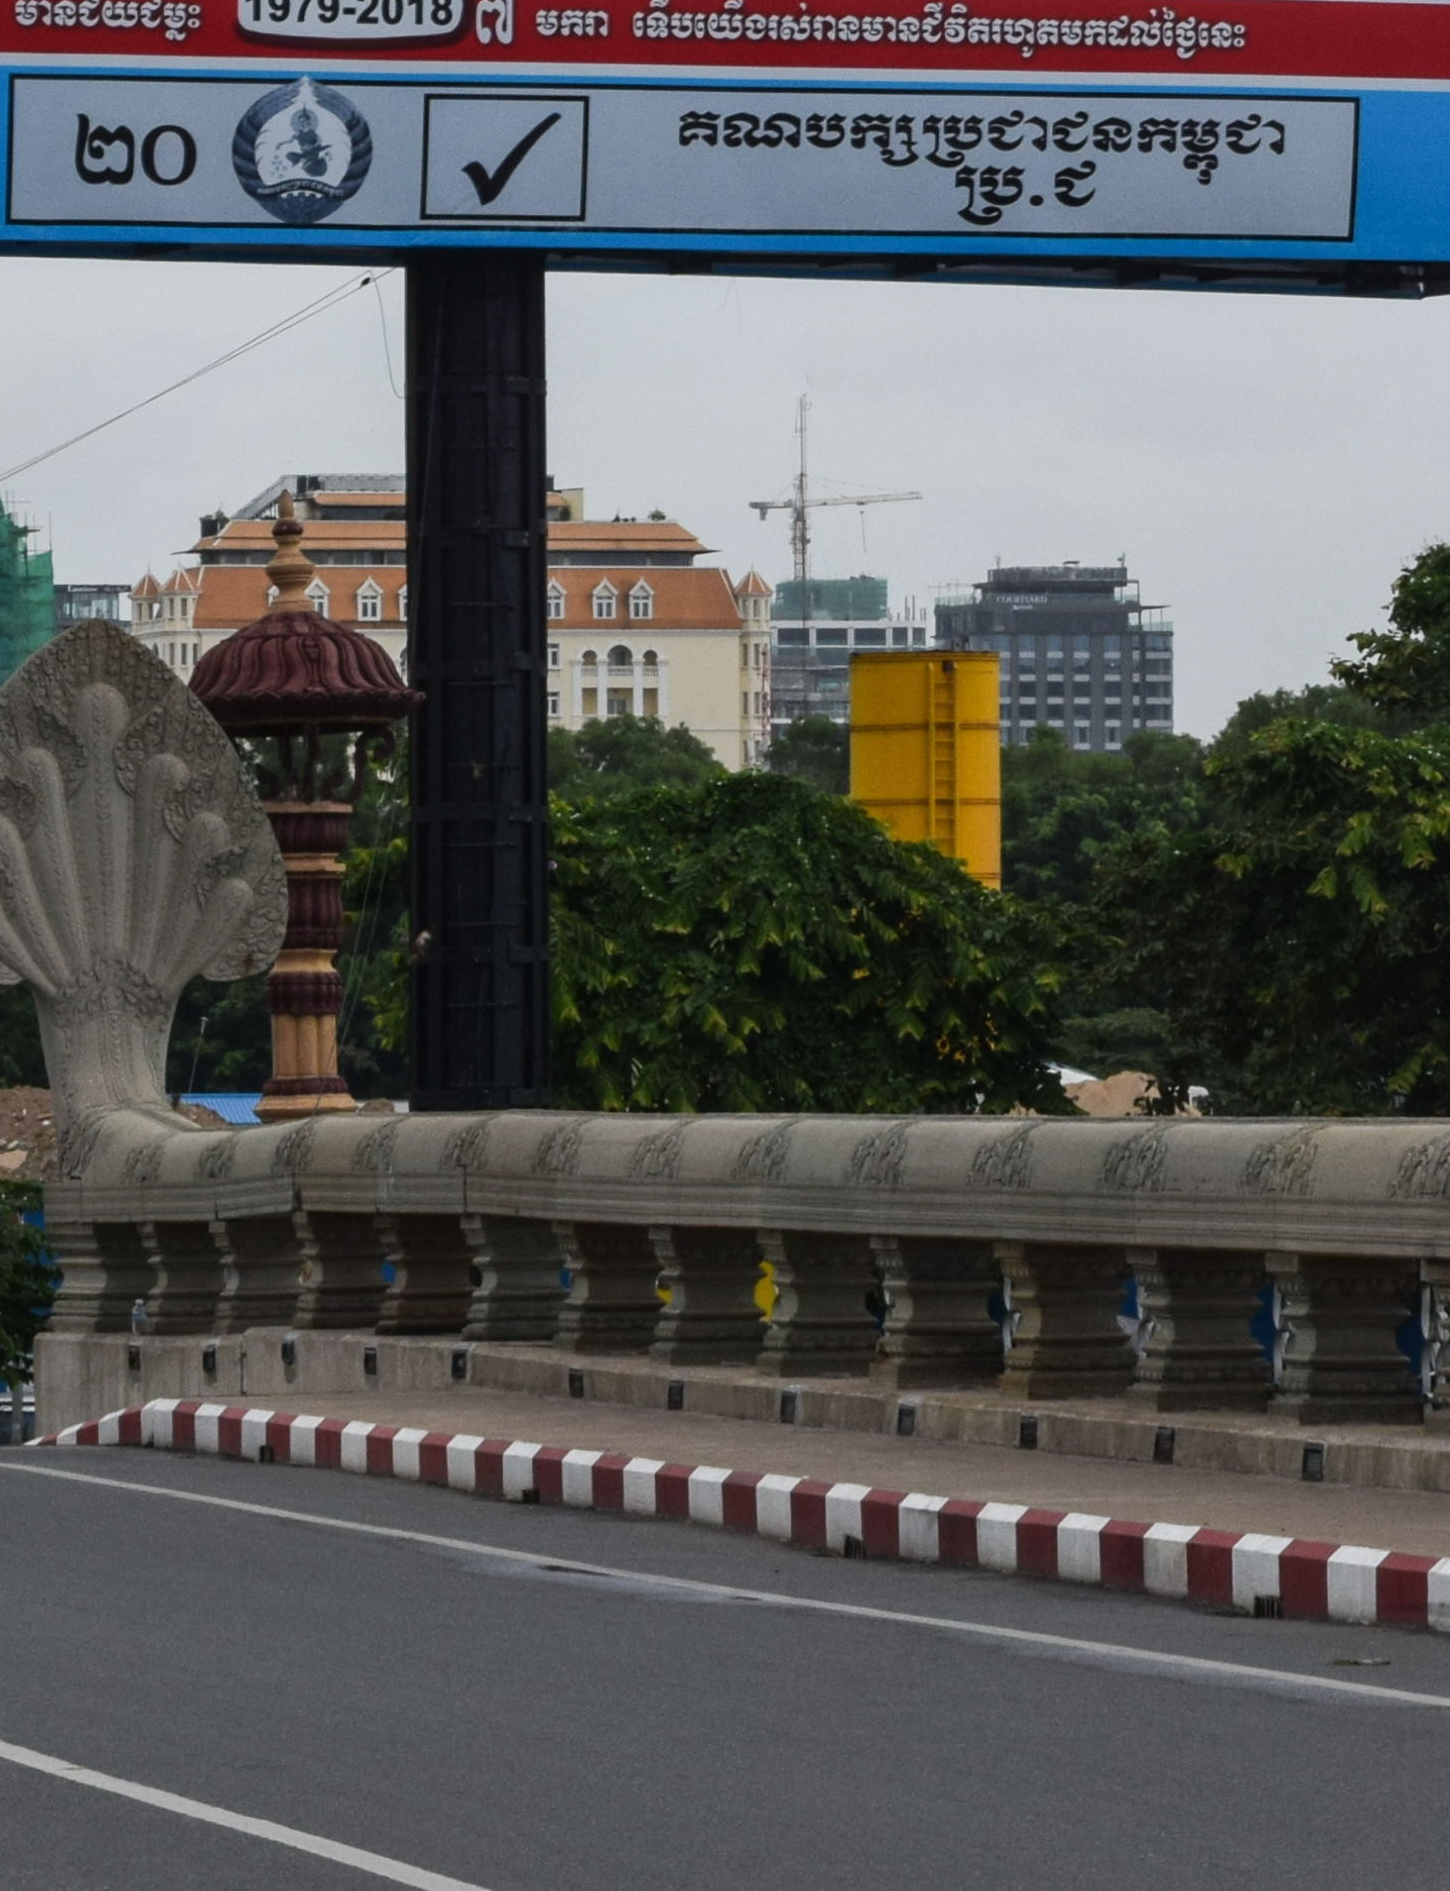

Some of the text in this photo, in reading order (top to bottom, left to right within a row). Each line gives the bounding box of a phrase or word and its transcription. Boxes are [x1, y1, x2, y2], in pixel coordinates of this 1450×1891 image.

[535, 9, 610, 37] មករា
[75, 113, 198, 186] ២០
[678, 110, 1286, 186] គណបក្សប្រជាជនកម្ពុជា
